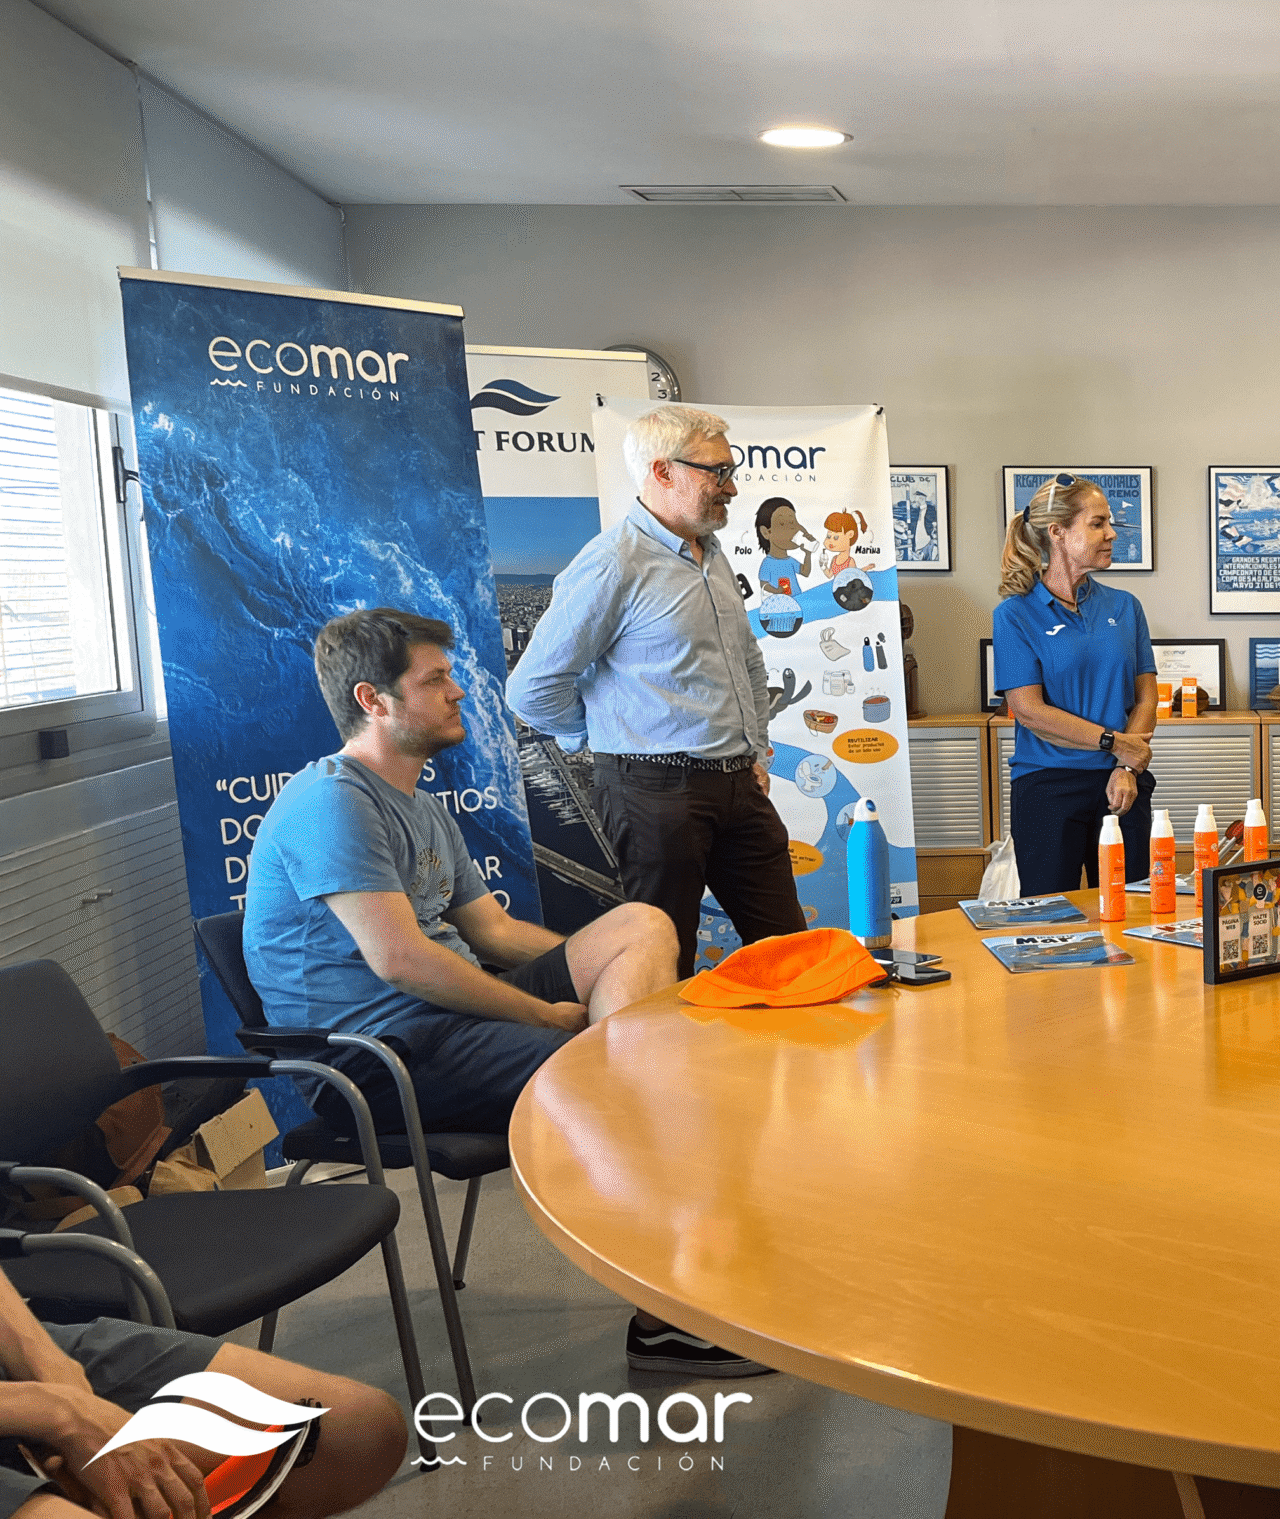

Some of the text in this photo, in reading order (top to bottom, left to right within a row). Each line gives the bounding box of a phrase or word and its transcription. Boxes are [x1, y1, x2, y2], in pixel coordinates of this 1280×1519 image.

[208, 336, 409, 384] ecomar
[651, 372, 661, 382] 2
[256, 381, 400, 401] FUNDACIÓN
[658, 389, 668, 399] 3
[730, 445, 826, 469] omar
[733, 472, 816, 482] NDACIÓN
[890, 475, 916, 483] CLUB
[1108, 490, 1140, 498] REMO
[734, 545, 752, 555] Polo
[854, 545, 881, 555] Marina
